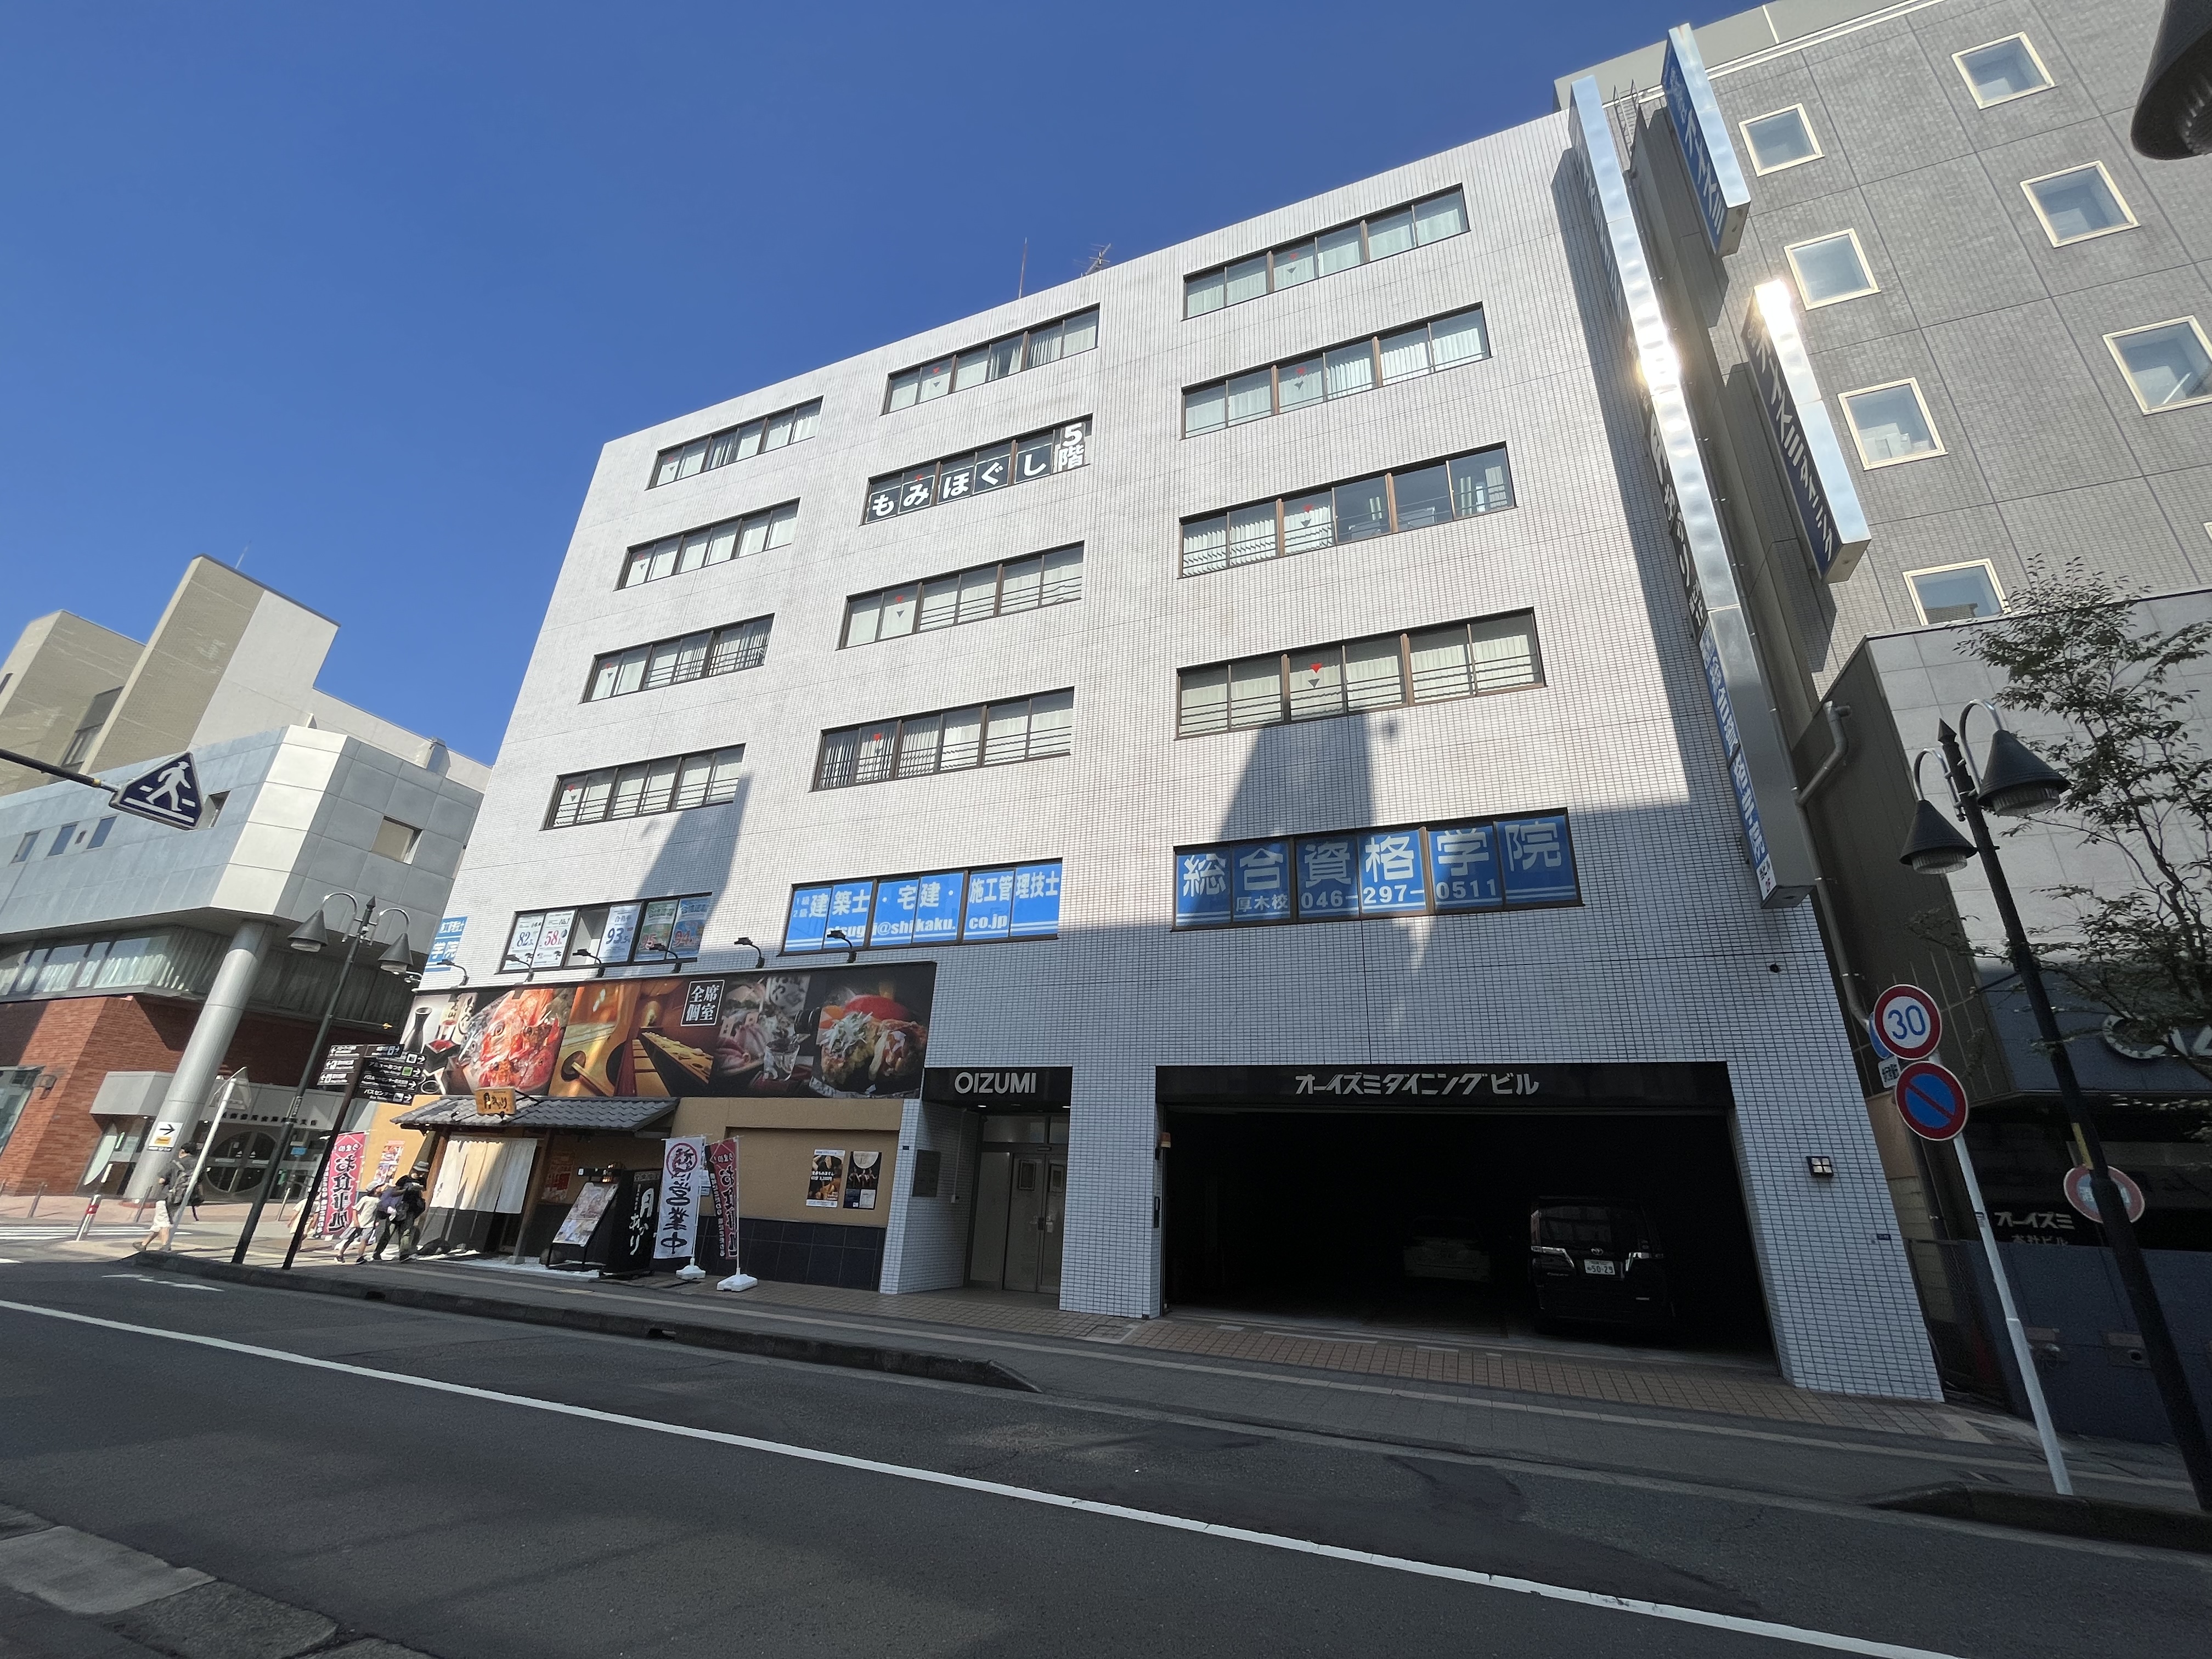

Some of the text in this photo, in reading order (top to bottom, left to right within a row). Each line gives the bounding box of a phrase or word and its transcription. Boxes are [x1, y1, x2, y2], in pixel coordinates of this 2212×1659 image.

[1059, 422, 1084, 468] 5階
[872, 454, 1046, 516] もみほぐし
[1183, 821, 1562, 897] 総合資格学院
[1235, 895, 1288, 912] 厚木校
[1301, 879, 1498, 908] 046-297-0511
[689, 984, 720, 1003] 全席
[686, 1003, 716, 1021] 個室
[1887, 1005, 1926, 1040] 30
[955, 1072, 1037, 1094] OIZUMI
[1295, 1072, 1540, 1095] オーイズミダイニングビル
[629, 1188, 654, 1255] 月あかり
[1994, 1211, 2075, 1229] オーイズミ
